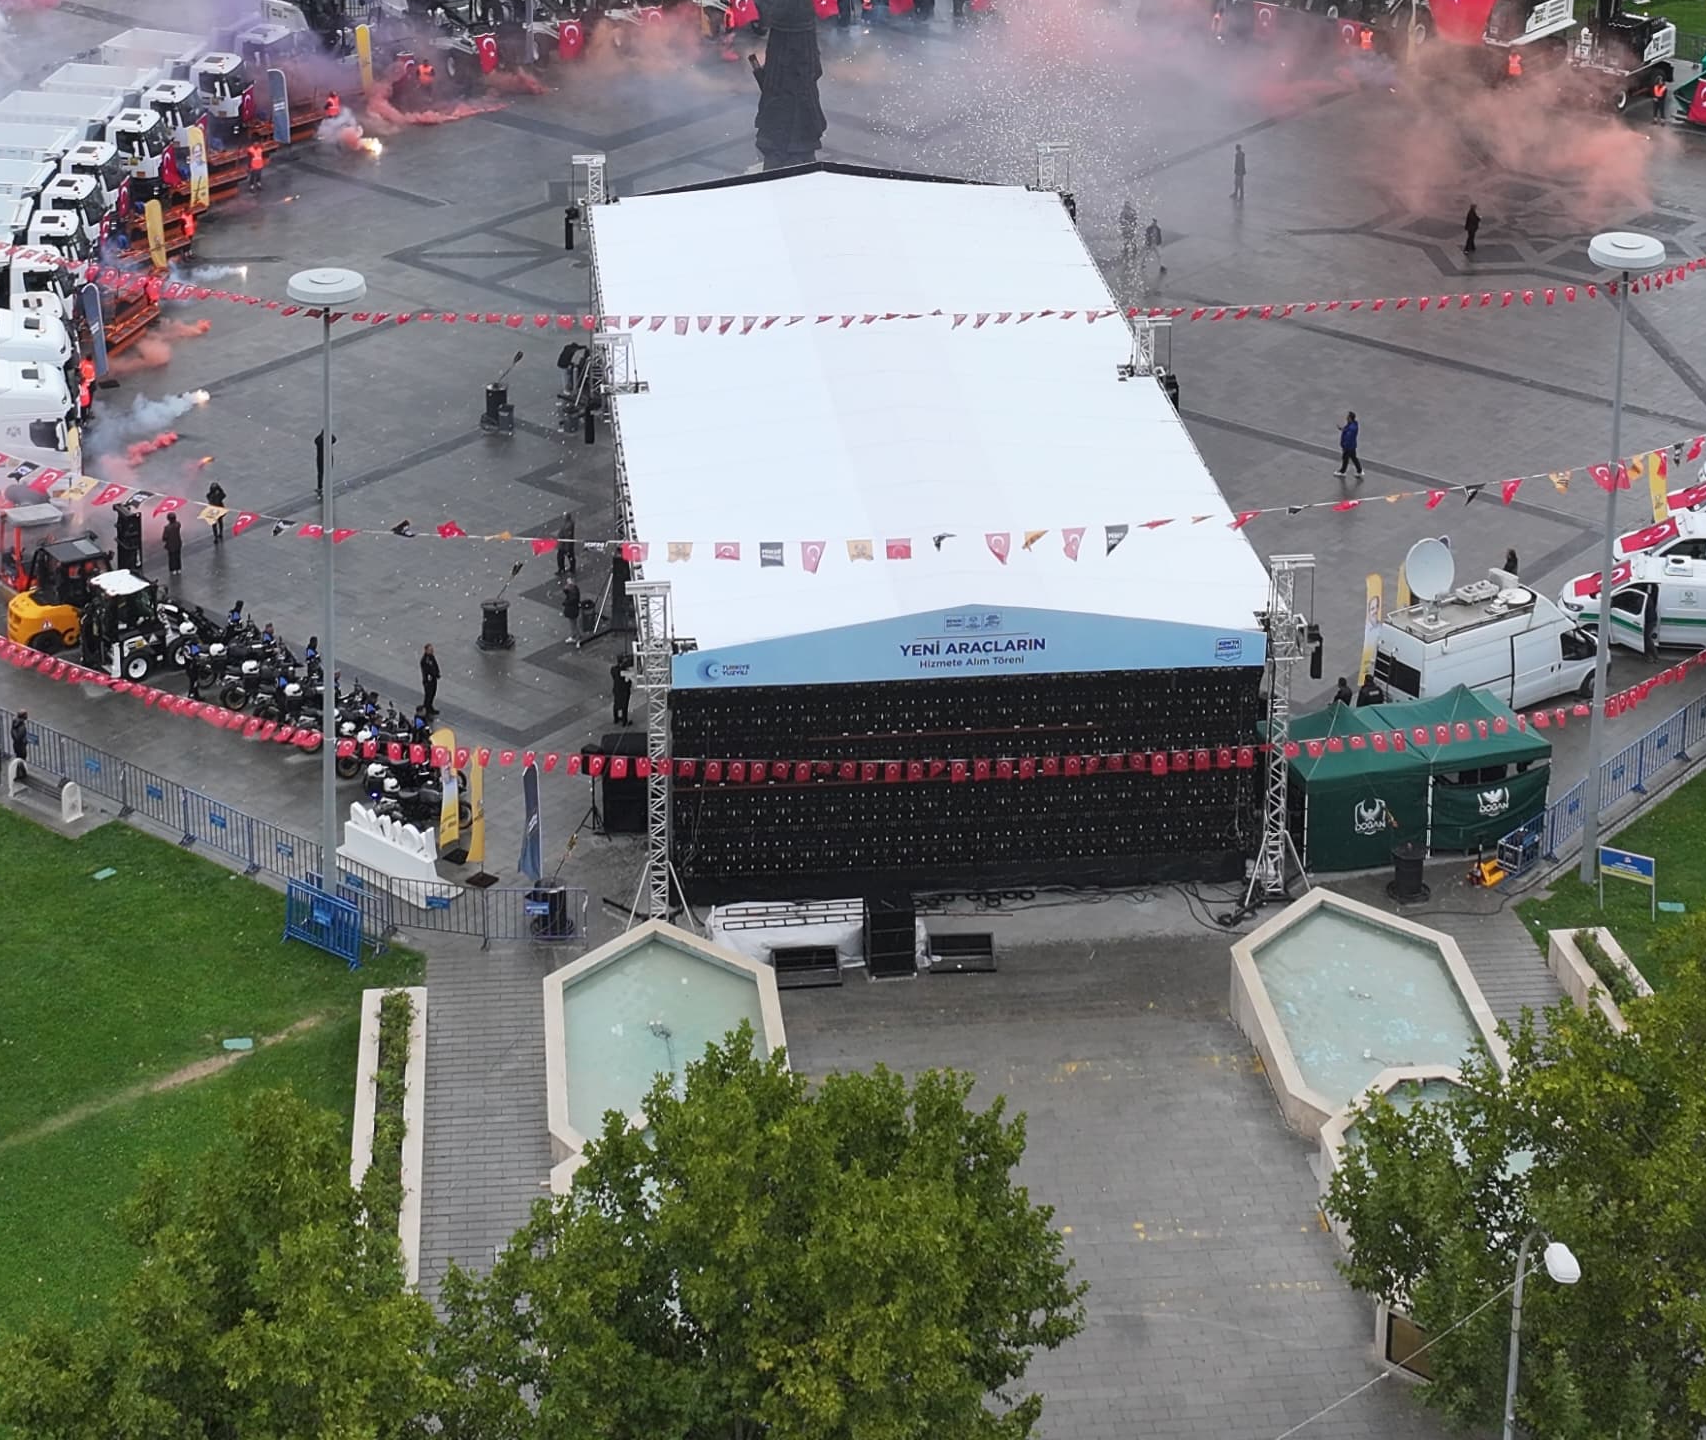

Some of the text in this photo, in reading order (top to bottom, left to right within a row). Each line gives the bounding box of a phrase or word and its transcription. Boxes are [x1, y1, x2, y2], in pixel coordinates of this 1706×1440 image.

[900, 638, 1046, 658] YENİ ARAÇLARIN
[919, 655, 1025, 670] Hizmete Alım Töreni
